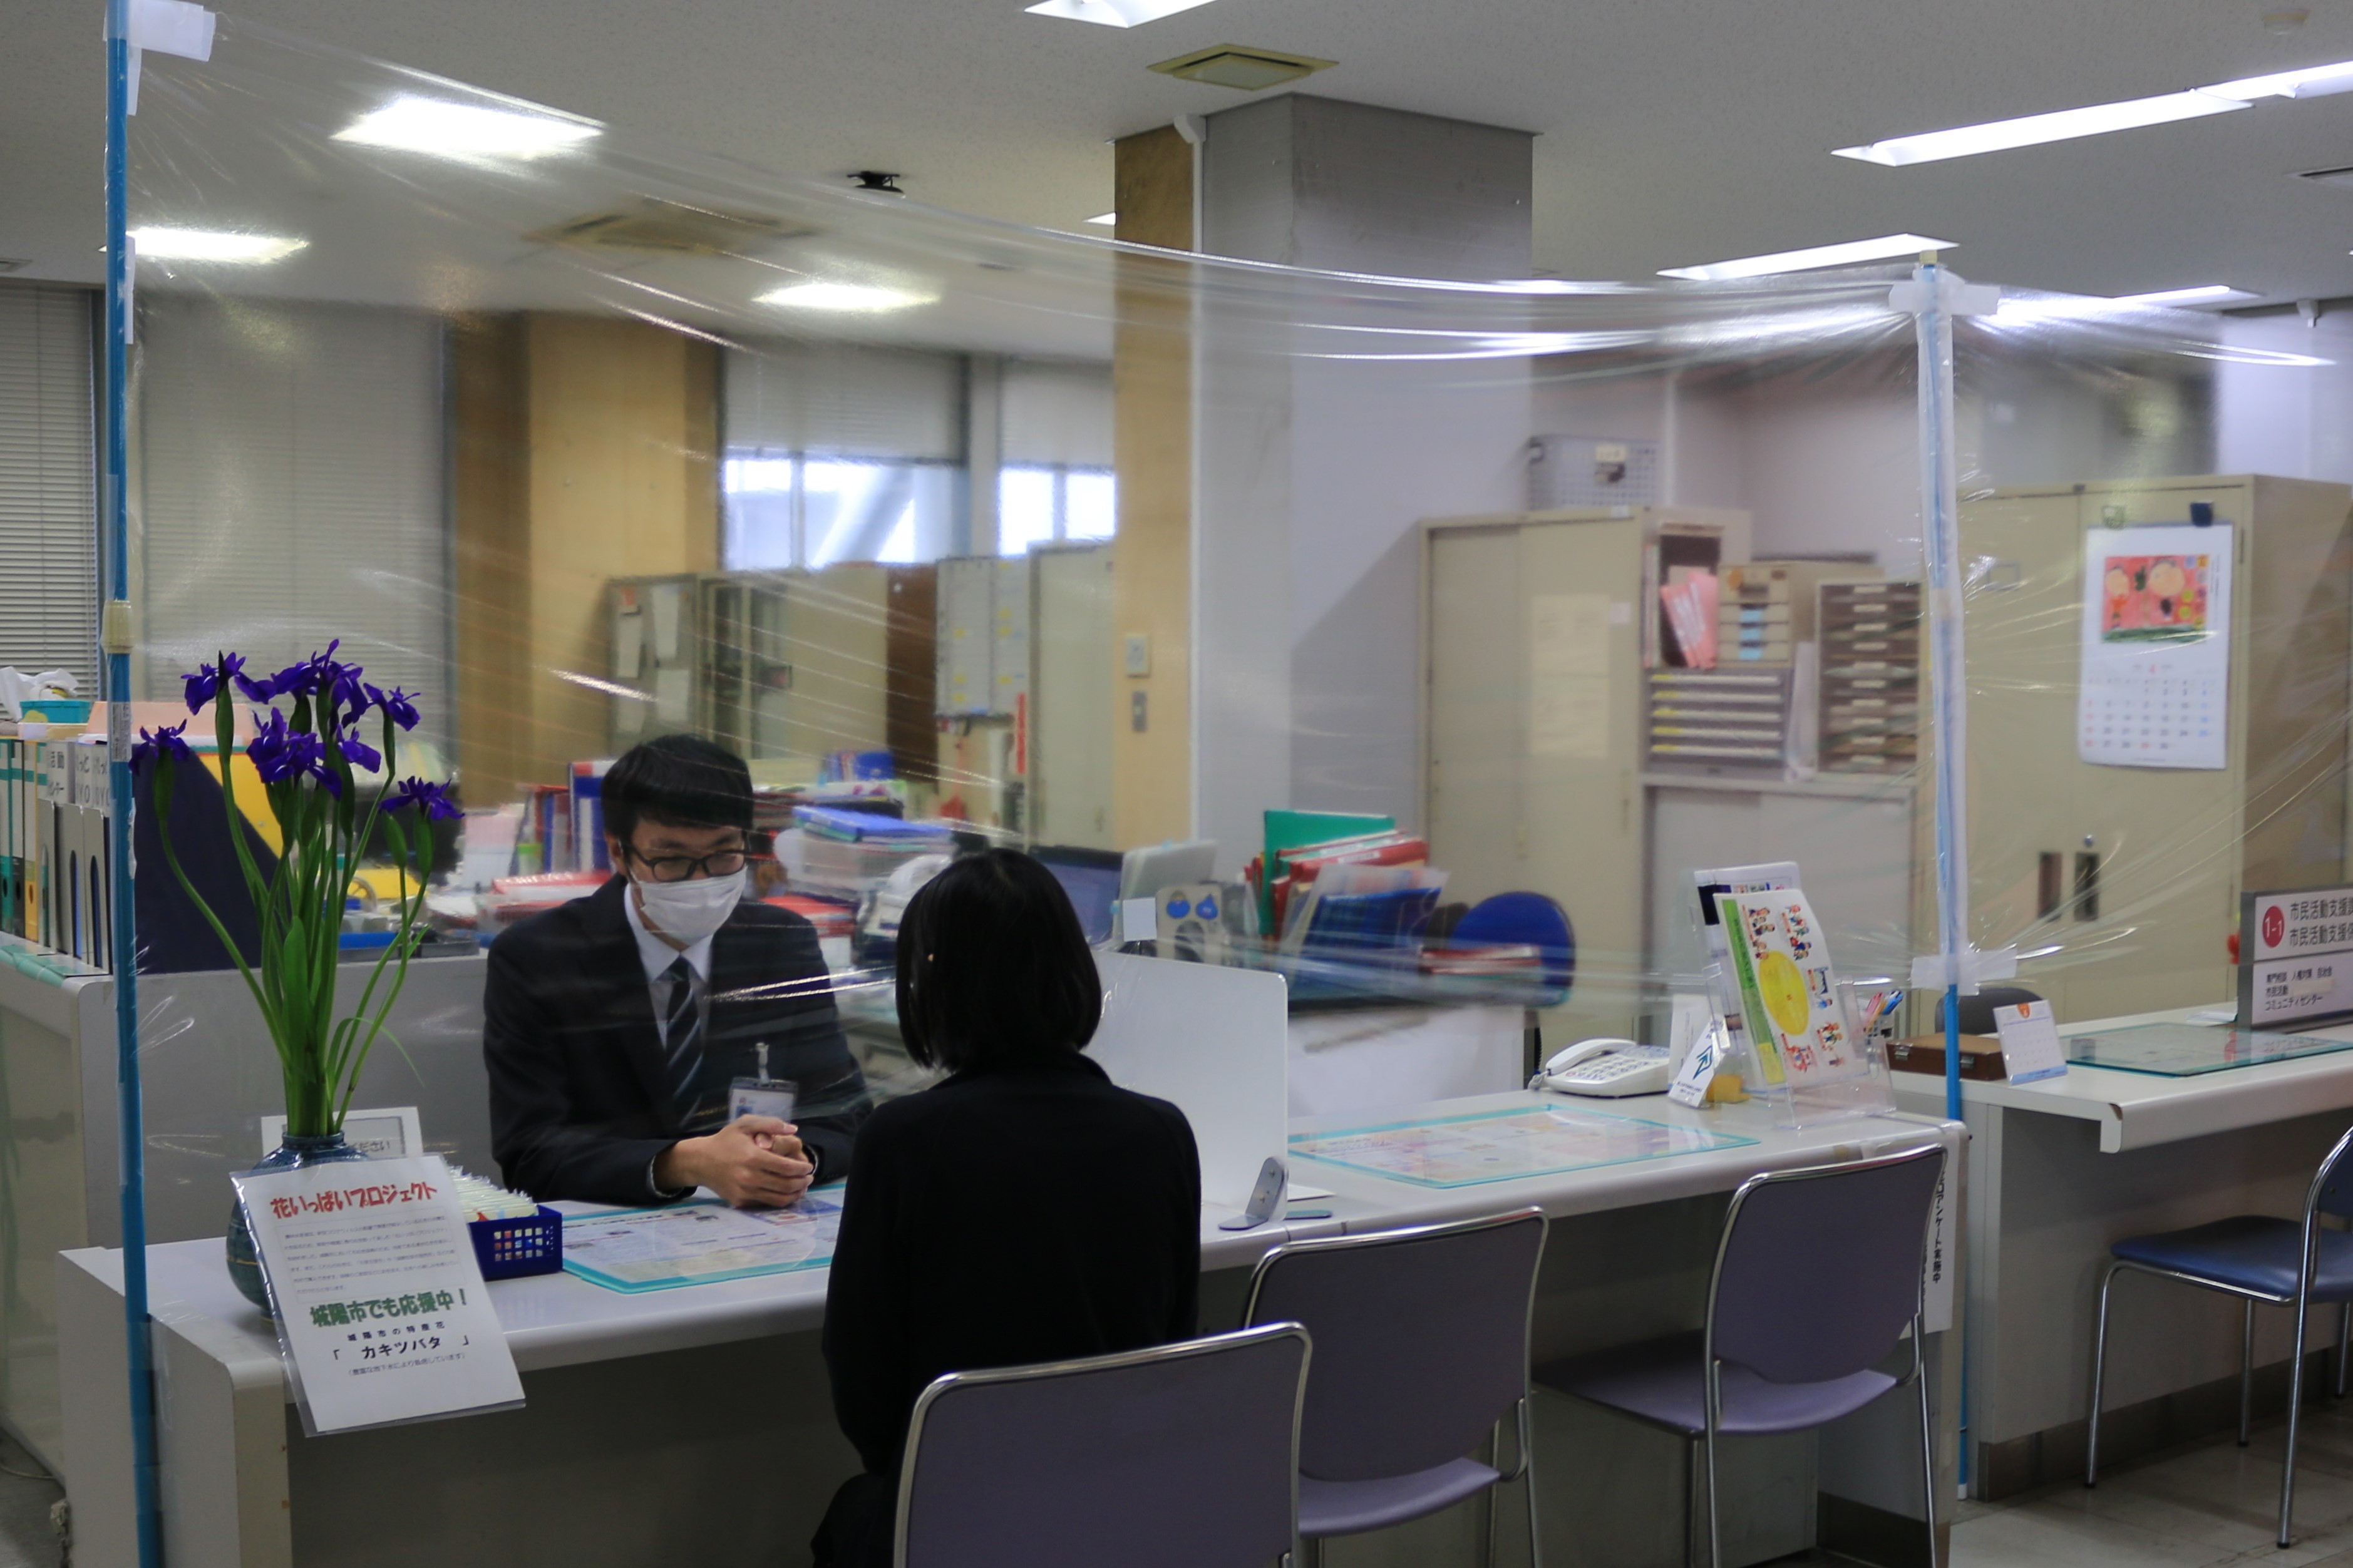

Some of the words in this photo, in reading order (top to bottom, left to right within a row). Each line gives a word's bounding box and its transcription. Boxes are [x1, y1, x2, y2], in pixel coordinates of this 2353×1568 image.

[2264, 916, 2283, 939] 1-1
[2265, 984, 2289, 998] 市民活動
[2265, 995, 2324, 1011] コミュニティセンター
[270, 1181, 438, 1219] 花いっぱいプロジェクト
